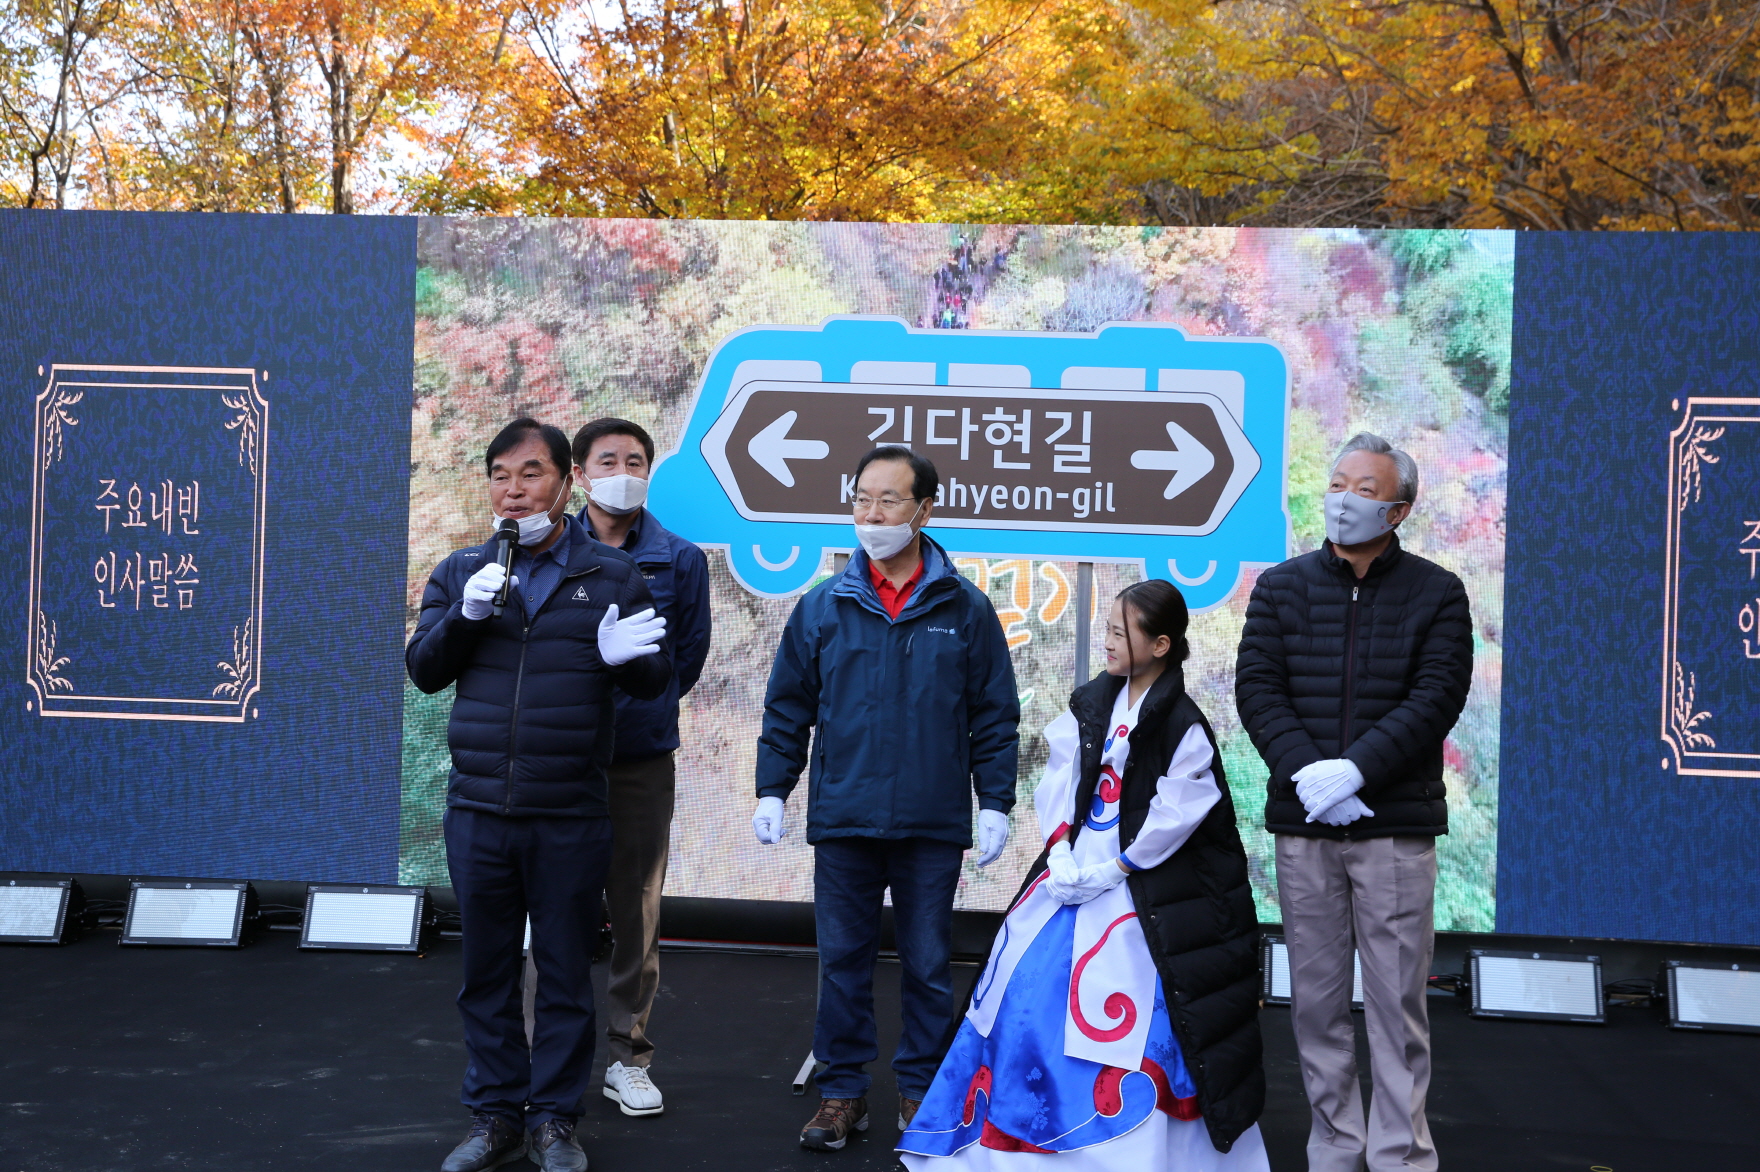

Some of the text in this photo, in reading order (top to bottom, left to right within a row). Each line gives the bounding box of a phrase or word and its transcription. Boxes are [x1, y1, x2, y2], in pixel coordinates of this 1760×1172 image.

[867, 405, 1092, 473] 김다현길
[95, 478, 199, 536] 주요내빈
[840, 473, 1116, 518] Kahyeon-gil
[94, 551, 199, 610] 인사말씀
